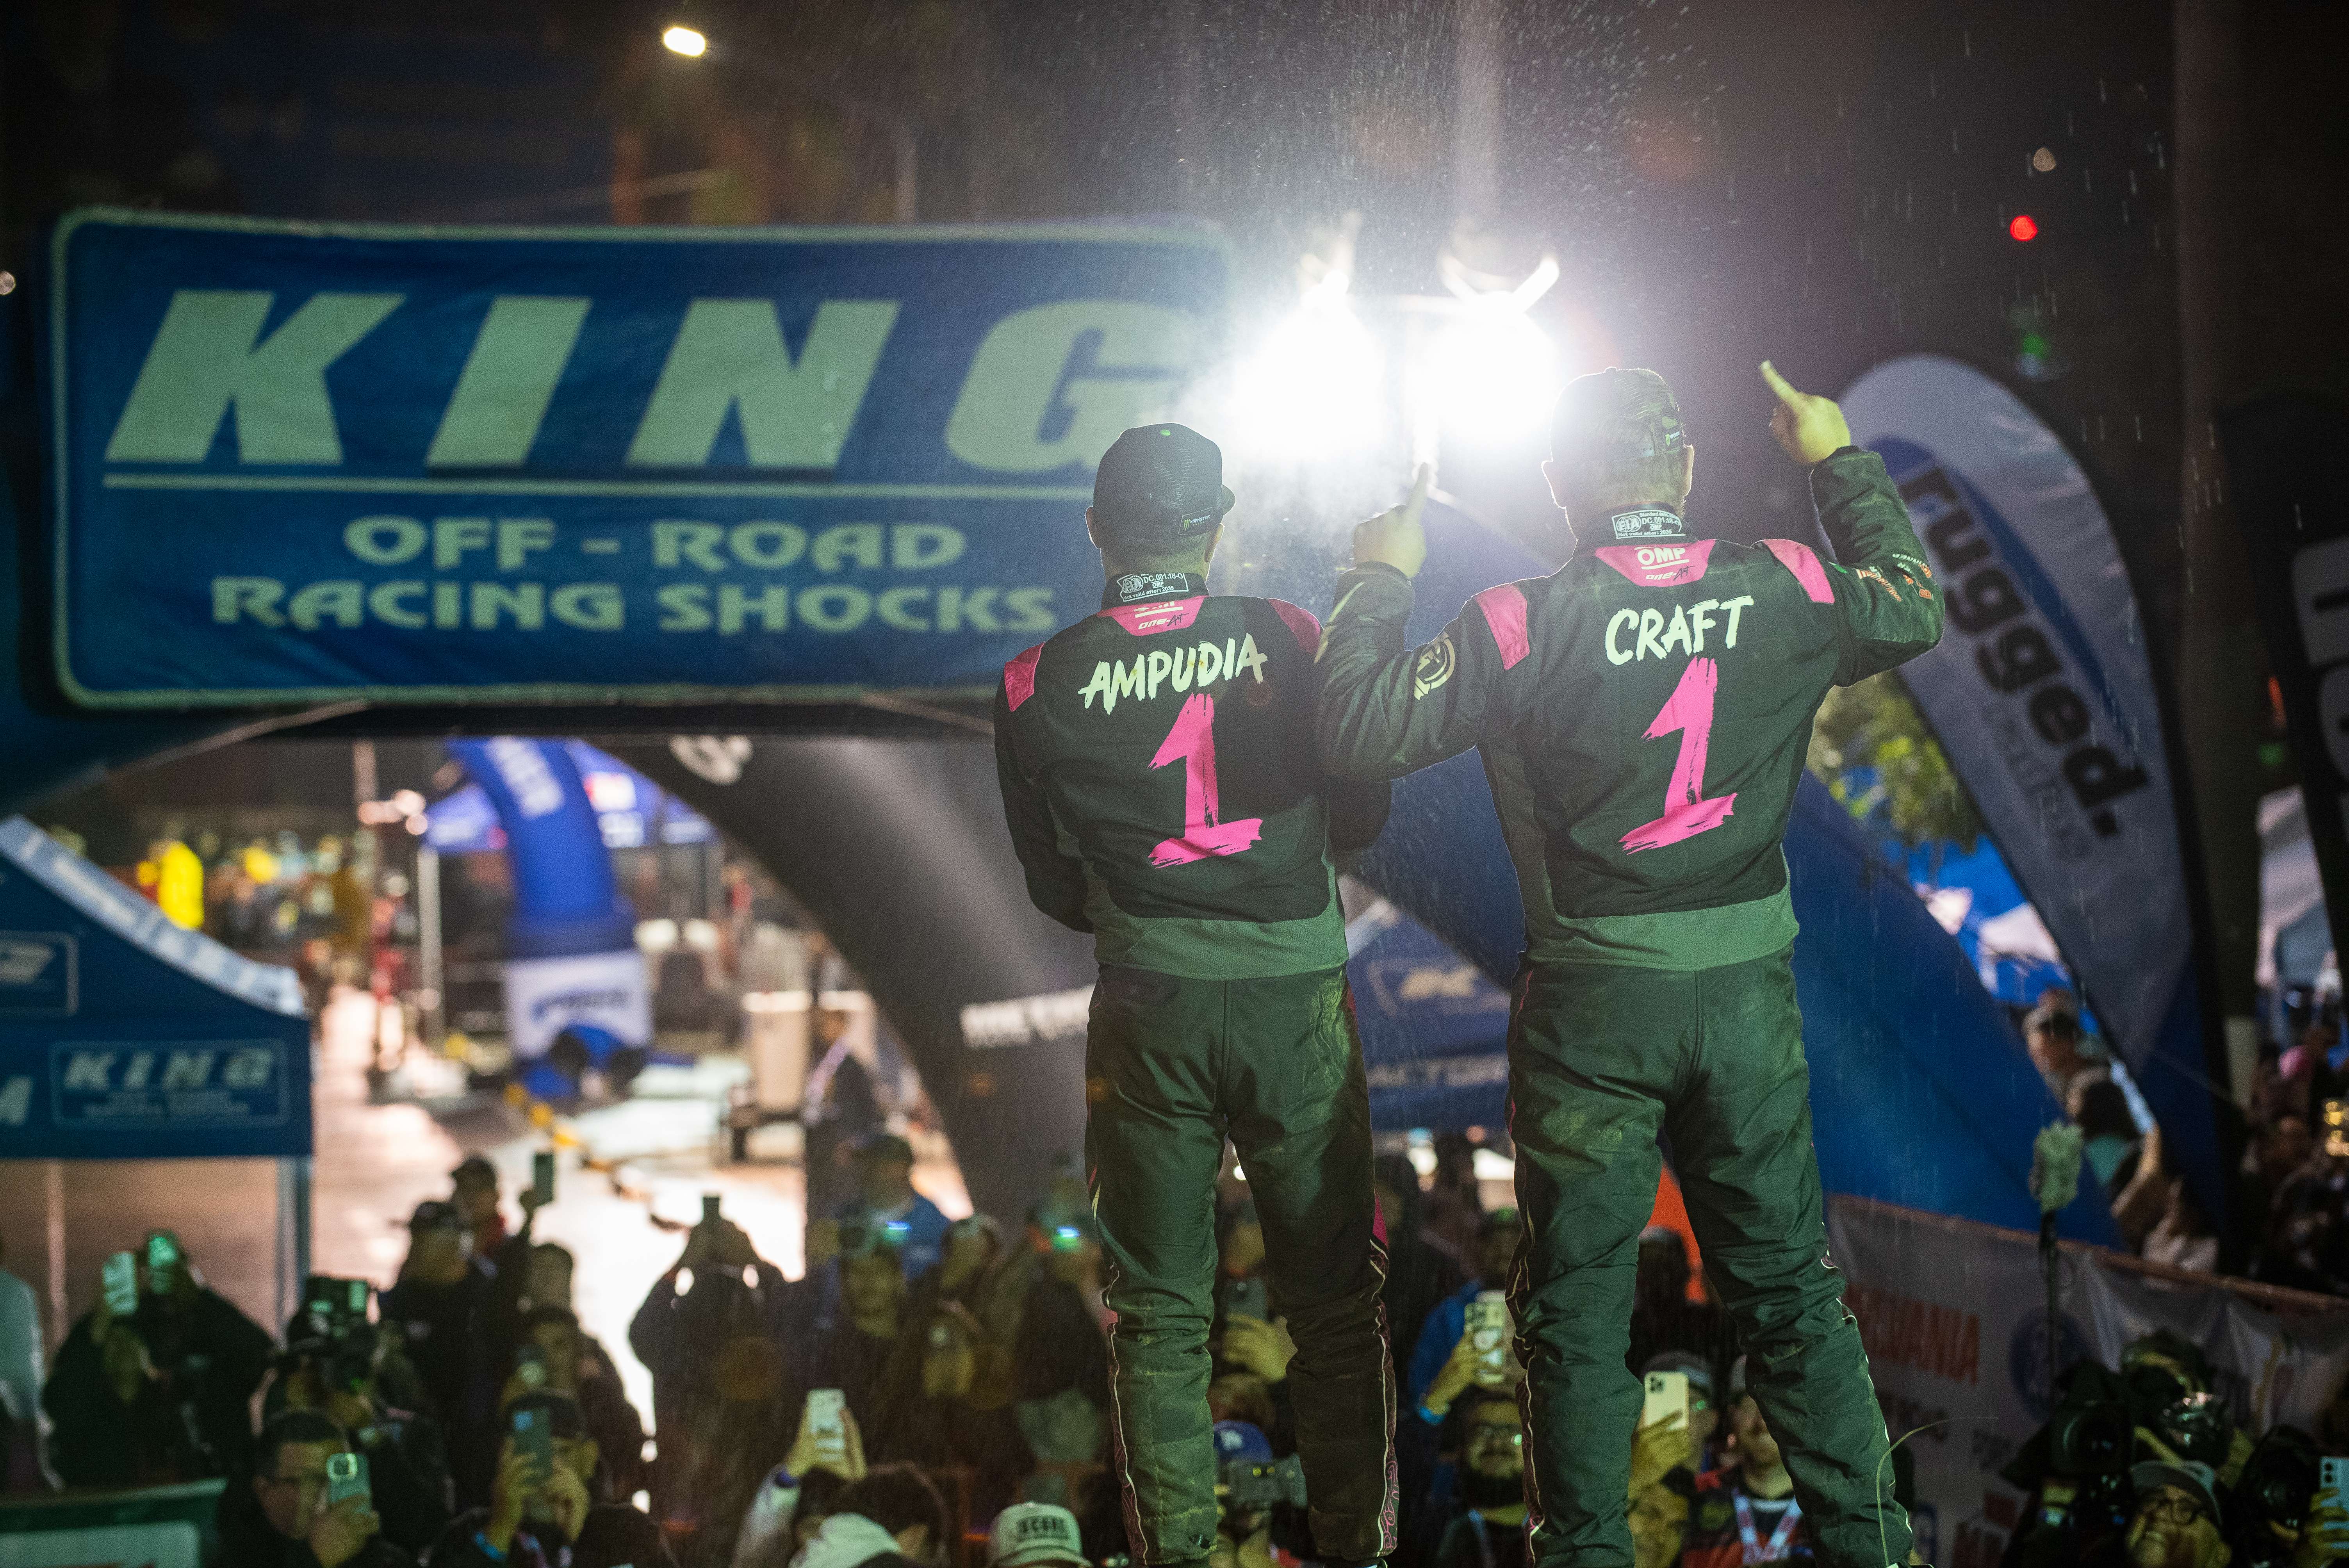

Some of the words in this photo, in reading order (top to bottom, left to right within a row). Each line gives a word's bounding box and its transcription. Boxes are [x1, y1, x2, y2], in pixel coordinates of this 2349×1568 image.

[105, 290, 1203, 474] KING
[344, 515, 556, 570] OFF
[651, 519, 966, 572] ROAD
[1190, 515, 1210, 524] MONSTER
[1637, 547, 1686, 565] OMP
[212, 575, 625, 631] RACING
[659, 585, 1057, 636] SHOCKS
[1605, 595, 1754, 665] CRAFT
[1078, 633, 1268, 715] AMPUDIA
[1147, 693, 1264, 870] 1
[1618, 655, 1738, 855] 1
